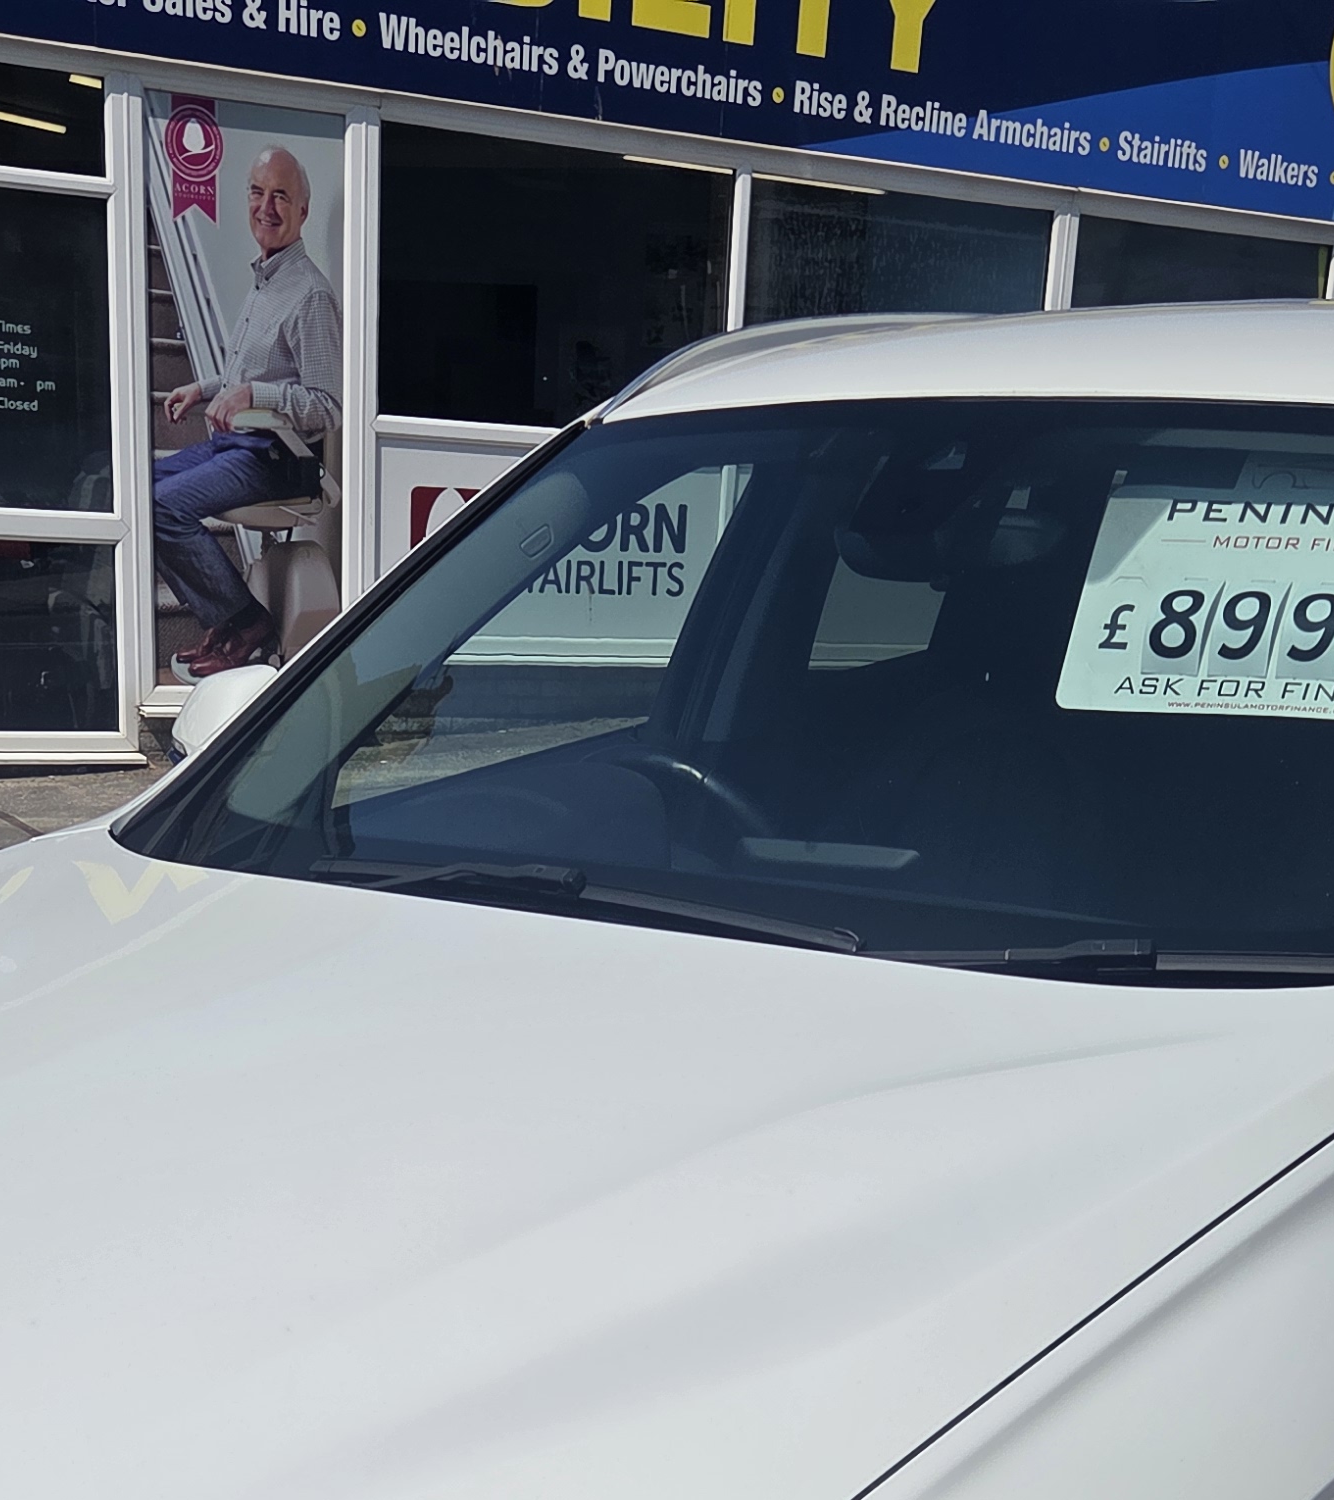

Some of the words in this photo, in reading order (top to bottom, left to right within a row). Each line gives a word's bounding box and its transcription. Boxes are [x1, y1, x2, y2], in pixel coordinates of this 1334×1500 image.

[278, 0, 341, 41] Hire
[379, 12, 559, 76] Wheelchairs
[567, 44, 589, 80] &
[597, 48, 763, 107] Powerchairs
[793, 80, 846, 120] Rise
[854, 92, 873, 125] &
[879, 94, 967, 140] Recline
[972, 110, 1092, 156] Armchairs
[1118, 131, 1208, 173] Stairlifts
[1239, 149, 1319, 188] Walkers
[174, 182, 215, 195] ACORN
[36, 380, 56, 392] pm
[578, 502, 688, 554] ORN
[1212, 535, 1299, 551] MOTOR
[528, 559, 685, 597] AIRLIFTS
[1114, 676, 1184, 696] ASK
[1197, 679, 1265, 699] FOR
